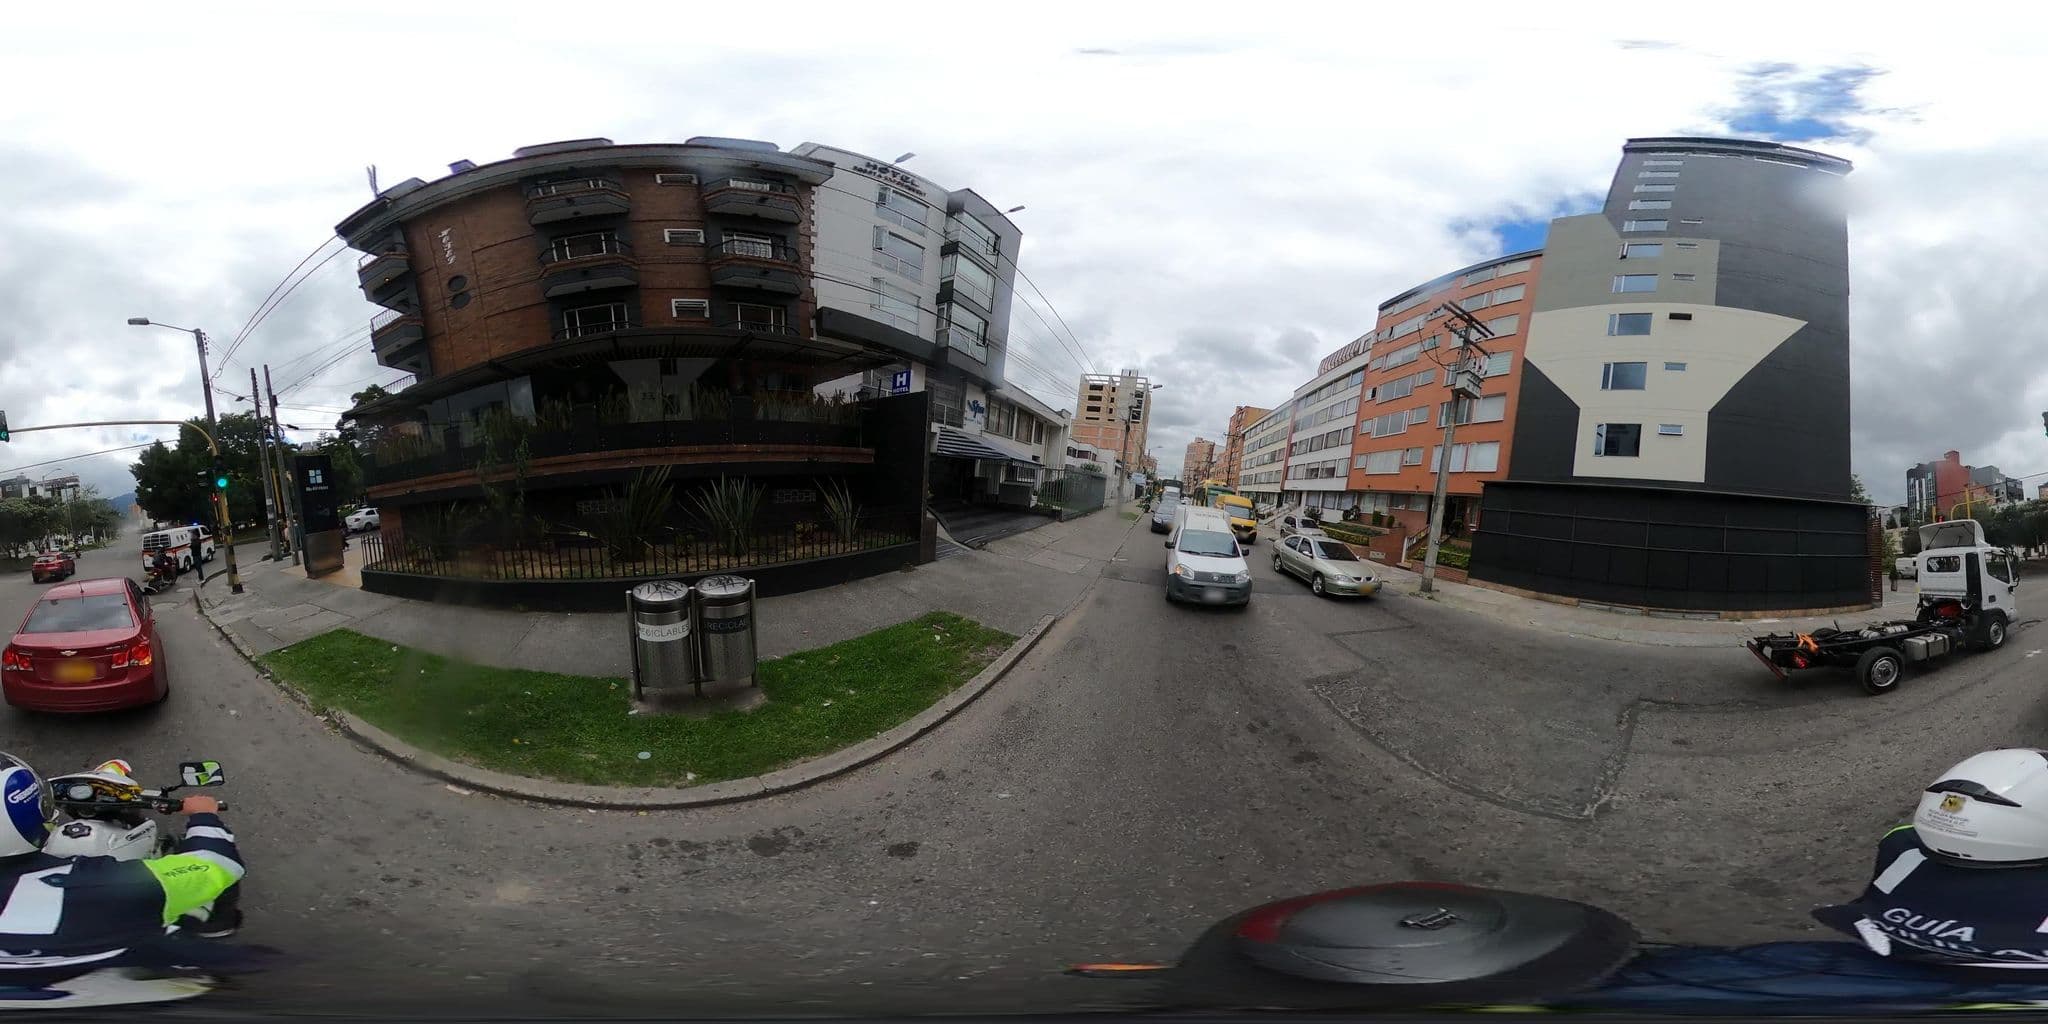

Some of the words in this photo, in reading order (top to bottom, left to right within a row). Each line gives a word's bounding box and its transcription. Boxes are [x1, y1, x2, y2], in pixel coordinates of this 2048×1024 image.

[865, 162, 920, 187] HOTEL
[896, 373, 907, 386] H
[893, 386, 908, 394] HOTEL
[1882, 907, 1975, 942] GUÍA
